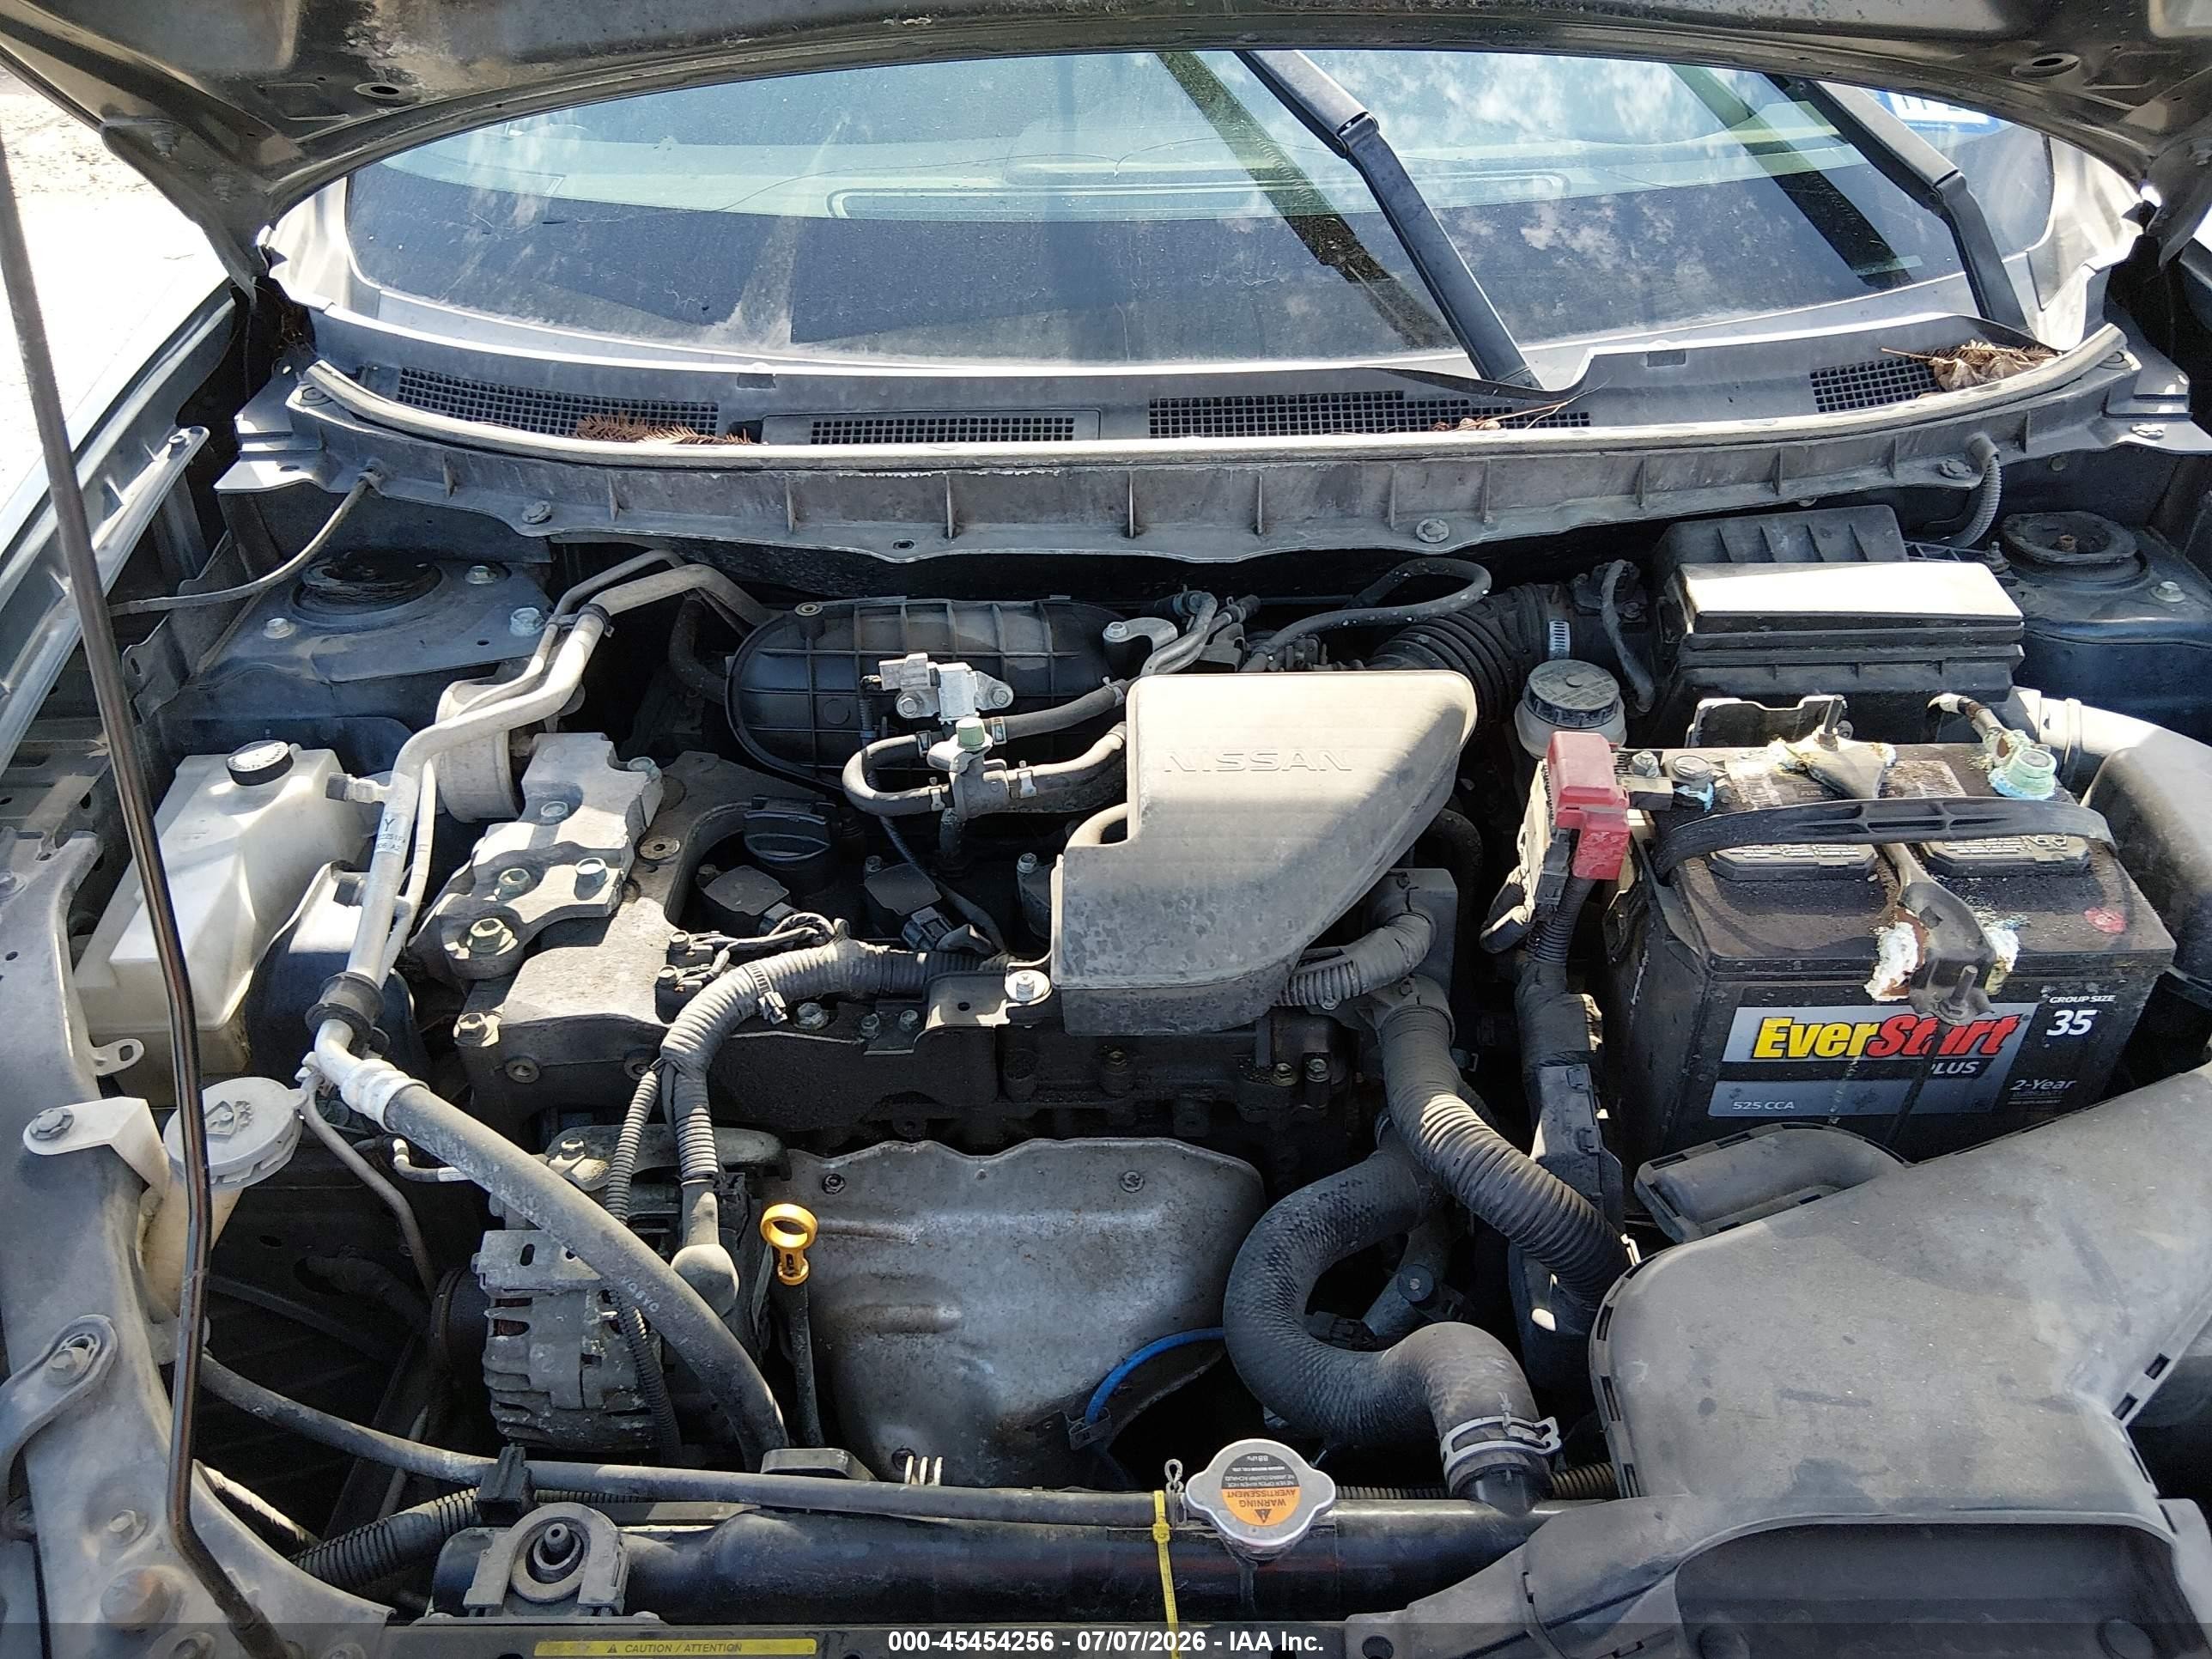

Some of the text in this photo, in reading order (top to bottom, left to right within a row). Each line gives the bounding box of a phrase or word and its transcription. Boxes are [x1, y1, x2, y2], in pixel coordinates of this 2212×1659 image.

[1164, 747, 1354, 773] NISSAN
[2049, 994, 2117, 1004] GROUP SIZE
[2046, 1009, 2098, 1036] 35
[2009, 1079, 2077, 1091] 2-Year
[1732, 1101, 1795, 1110] 525 CCA
[1227, 1489, 1297, 1498] AVERTISSEMENT
[1238, 1498, 1287, 1508] WARNING
[624, 1644, 672, 1653] CAUTION
[684, 1644, 743, 1653] ATTENTION
